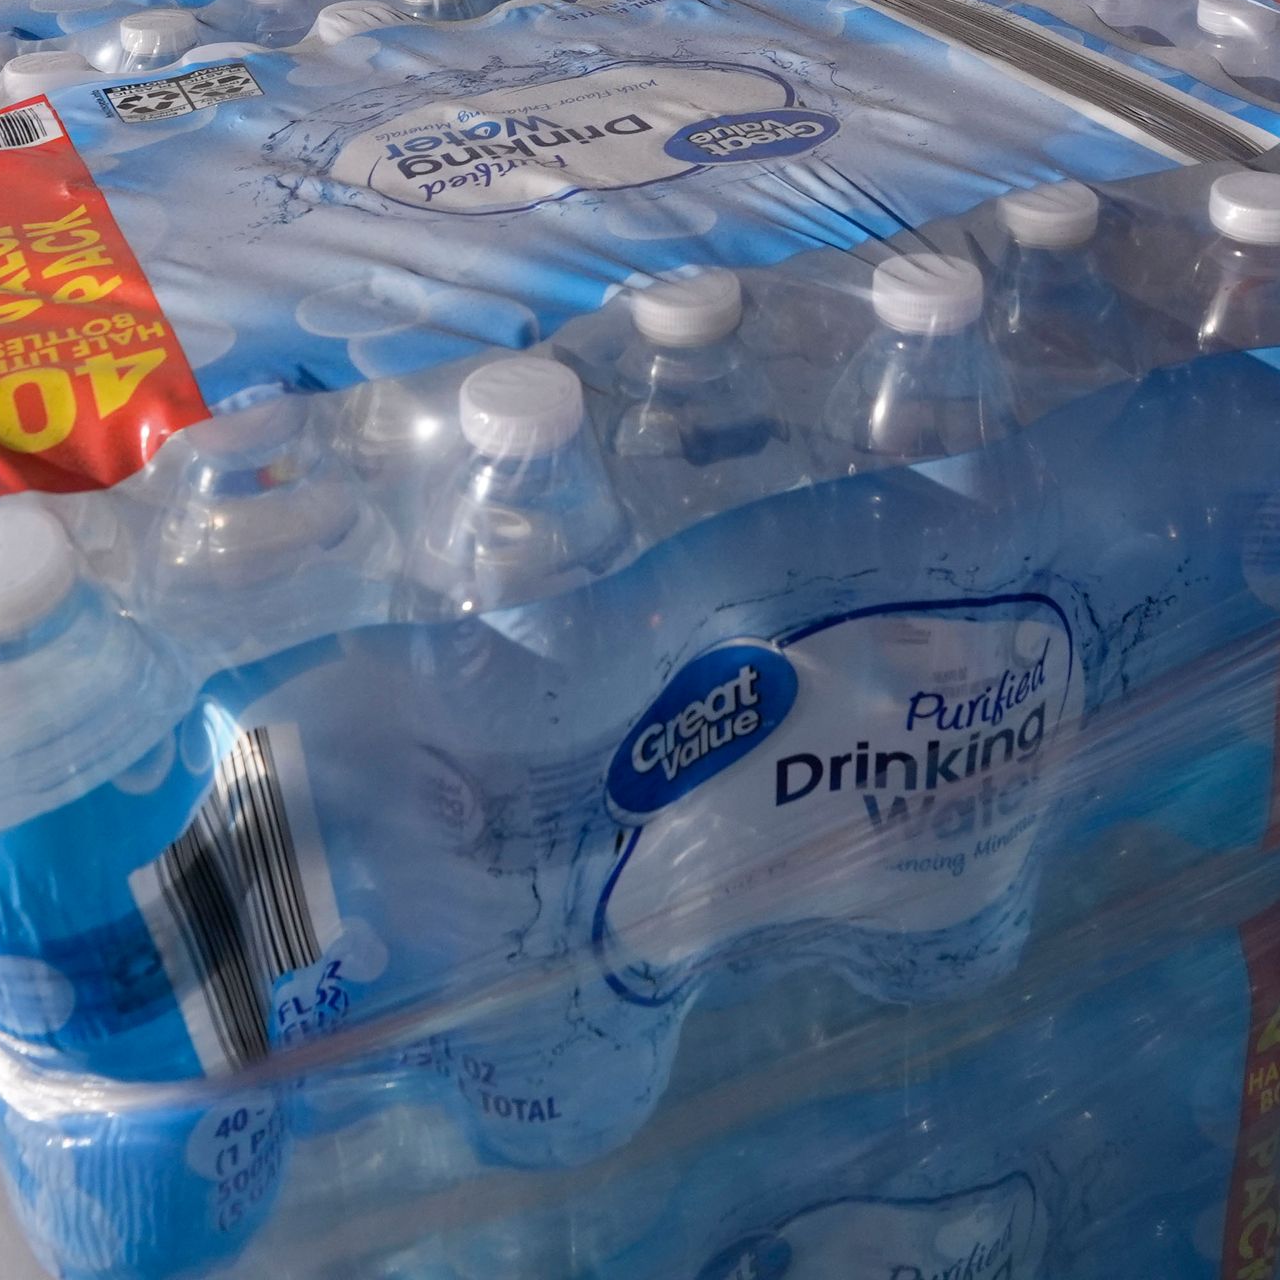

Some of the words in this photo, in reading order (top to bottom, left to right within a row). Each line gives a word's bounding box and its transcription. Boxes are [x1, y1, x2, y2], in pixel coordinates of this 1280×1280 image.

[373, 120, 452, 145] Minerals
[382, 113, 562, 164] Water
[395, 112, 655, 185] Drinking
[689, 118, 783, 145] Value
[708, 121, 825, 156] Great
[417, 151, 568, 203] Purified
[21, 203, 124, 305] PACK
[73, 319, 167, 360] HALF
[906, 635, 1053, 731] Purified
[631, 664, 759, 775] Great
[658, 708, 761, 781] Value
[773, 700, 1048, 808] Drinking
[214, 1107, 250, 1140] 40
[478, 1088, 564, 1124] TOTAL
